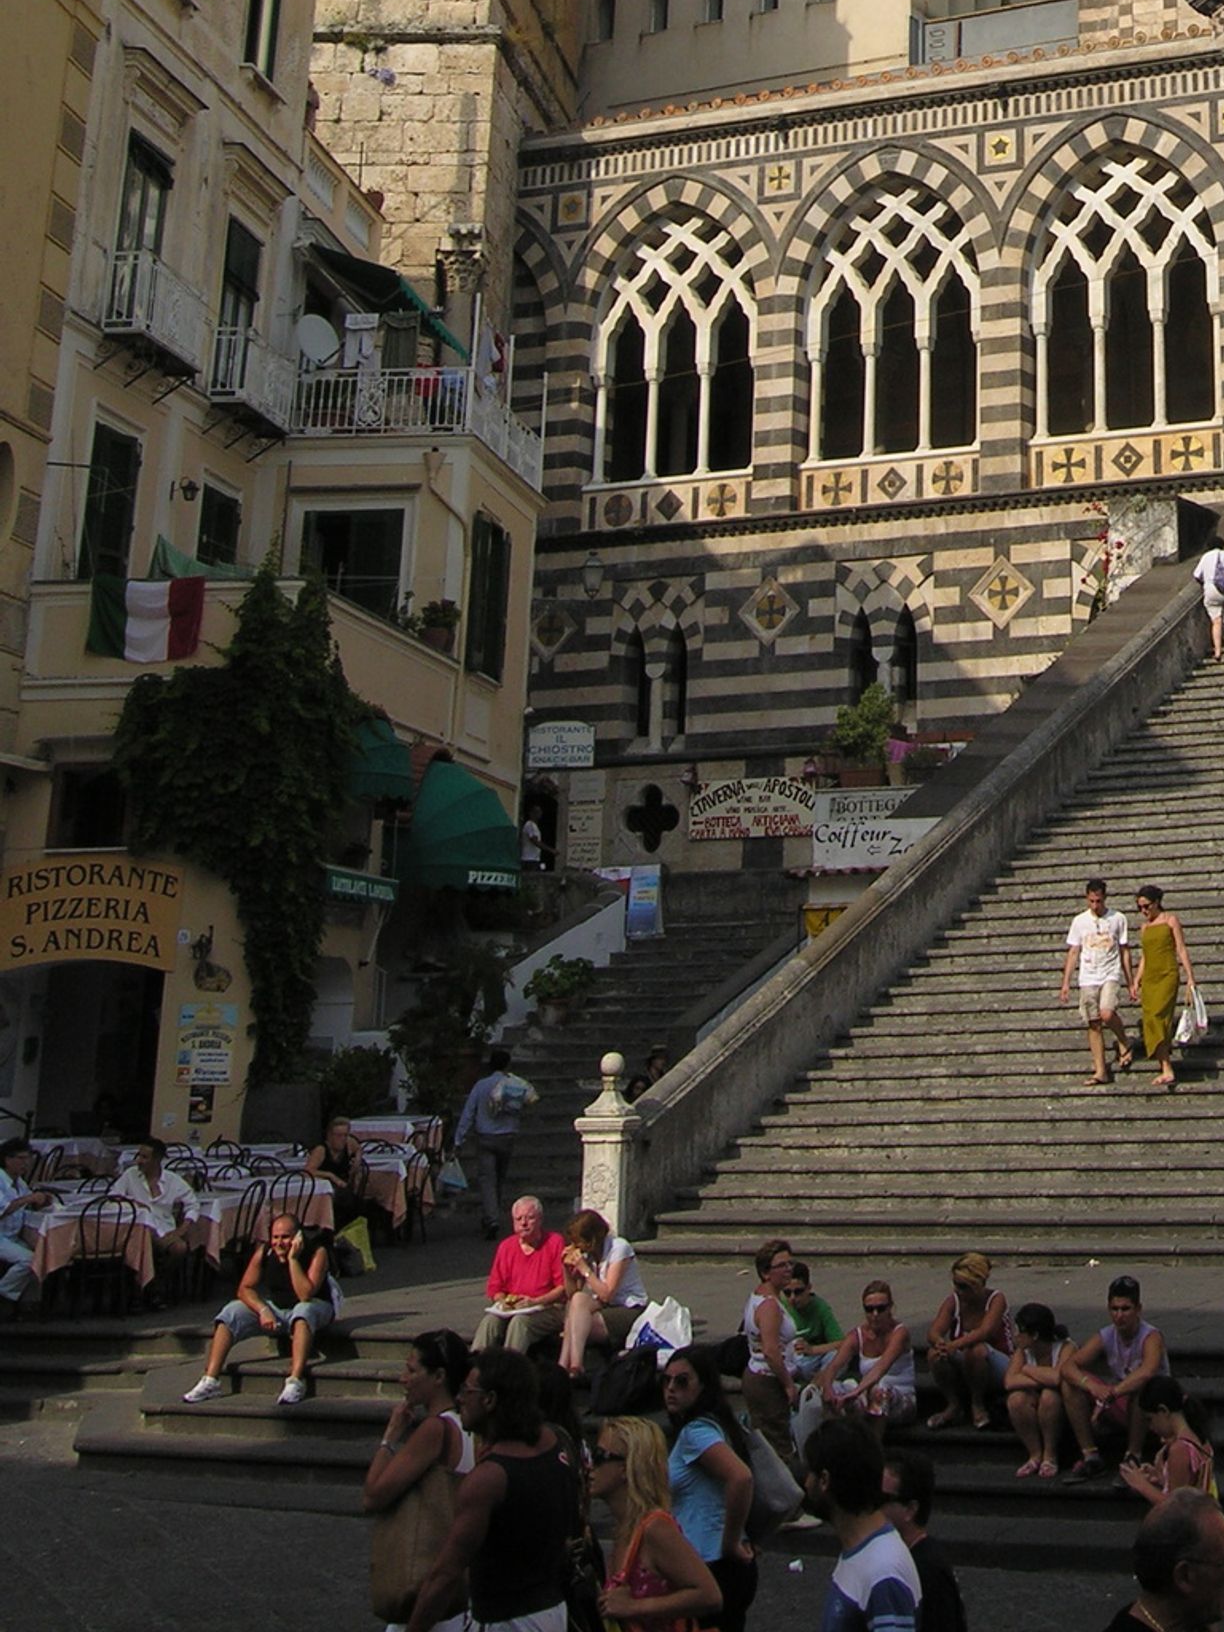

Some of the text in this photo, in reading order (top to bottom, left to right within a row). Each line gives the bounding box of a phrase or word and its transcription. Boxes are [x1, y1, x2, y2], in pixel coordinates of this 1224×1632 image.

[528, 744, 594, 755] CHIOSTRO
[555, 735, 567, 744] IL
[814, 821, 892, 849] Coiffeur
[7, 863, 179, 898] RISTORANTE
[25, 897, 151, 925] PIZZERIA
[10, 935, 34, 958] S.
[41, 928, 161, 958] ANDREA
